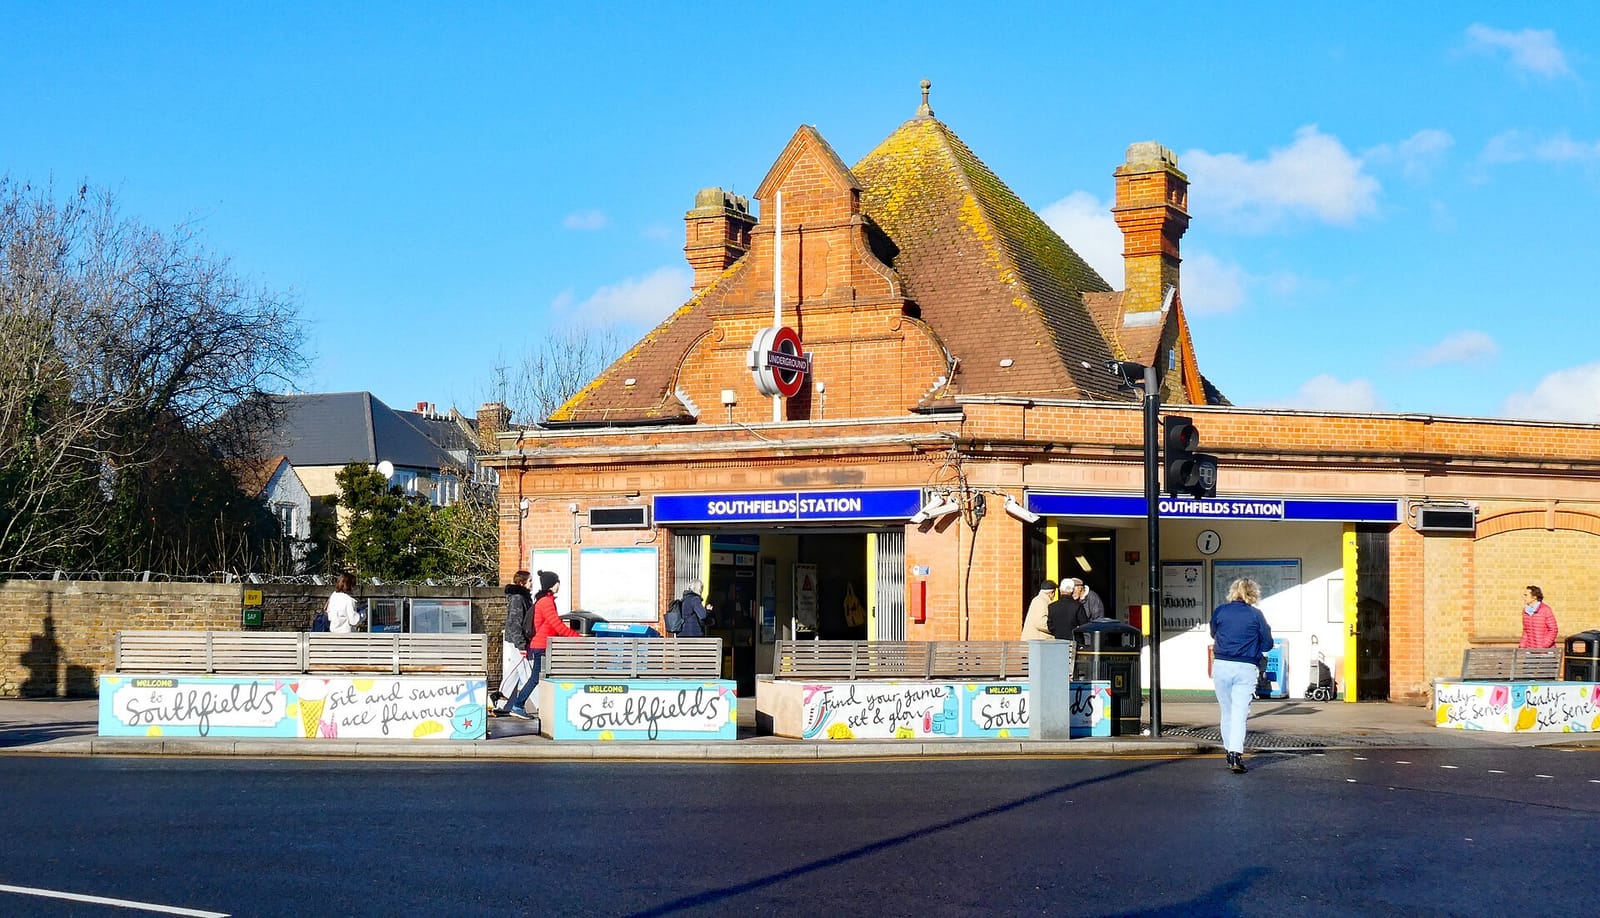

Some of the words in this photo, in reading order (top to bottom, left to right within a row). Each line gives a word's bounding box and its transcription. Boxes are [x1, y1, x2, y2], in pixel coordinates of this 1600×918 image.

[769, 354, 806, 370] UNDERGROUND
[708, 499, 796, 515] SOUTHFIELDS
[800, 497, 861, 513] STATION
[1158, 501, 1230, 515] OUTHFIELDS
[1231, 502, 1282, 516] STATION
[150, 691, 163, 703] to
[365, 682, 403, 704] and
[409, 682, 465, 701] savour
[602, 696, 614, 709] to
[823, 684, 861, 711] Find
[866, 692, 899, 711] your
[1000, 696, 1010, 709] to
[126, 681, 276, 737] Southfields
[342, 711, 376, 726] ace
[381, 703, 455, 735] flavours
[579, 687, 720, 740] Southfields
[872, 707, 884, 725] &
[889, 698, 934, 733] glow
